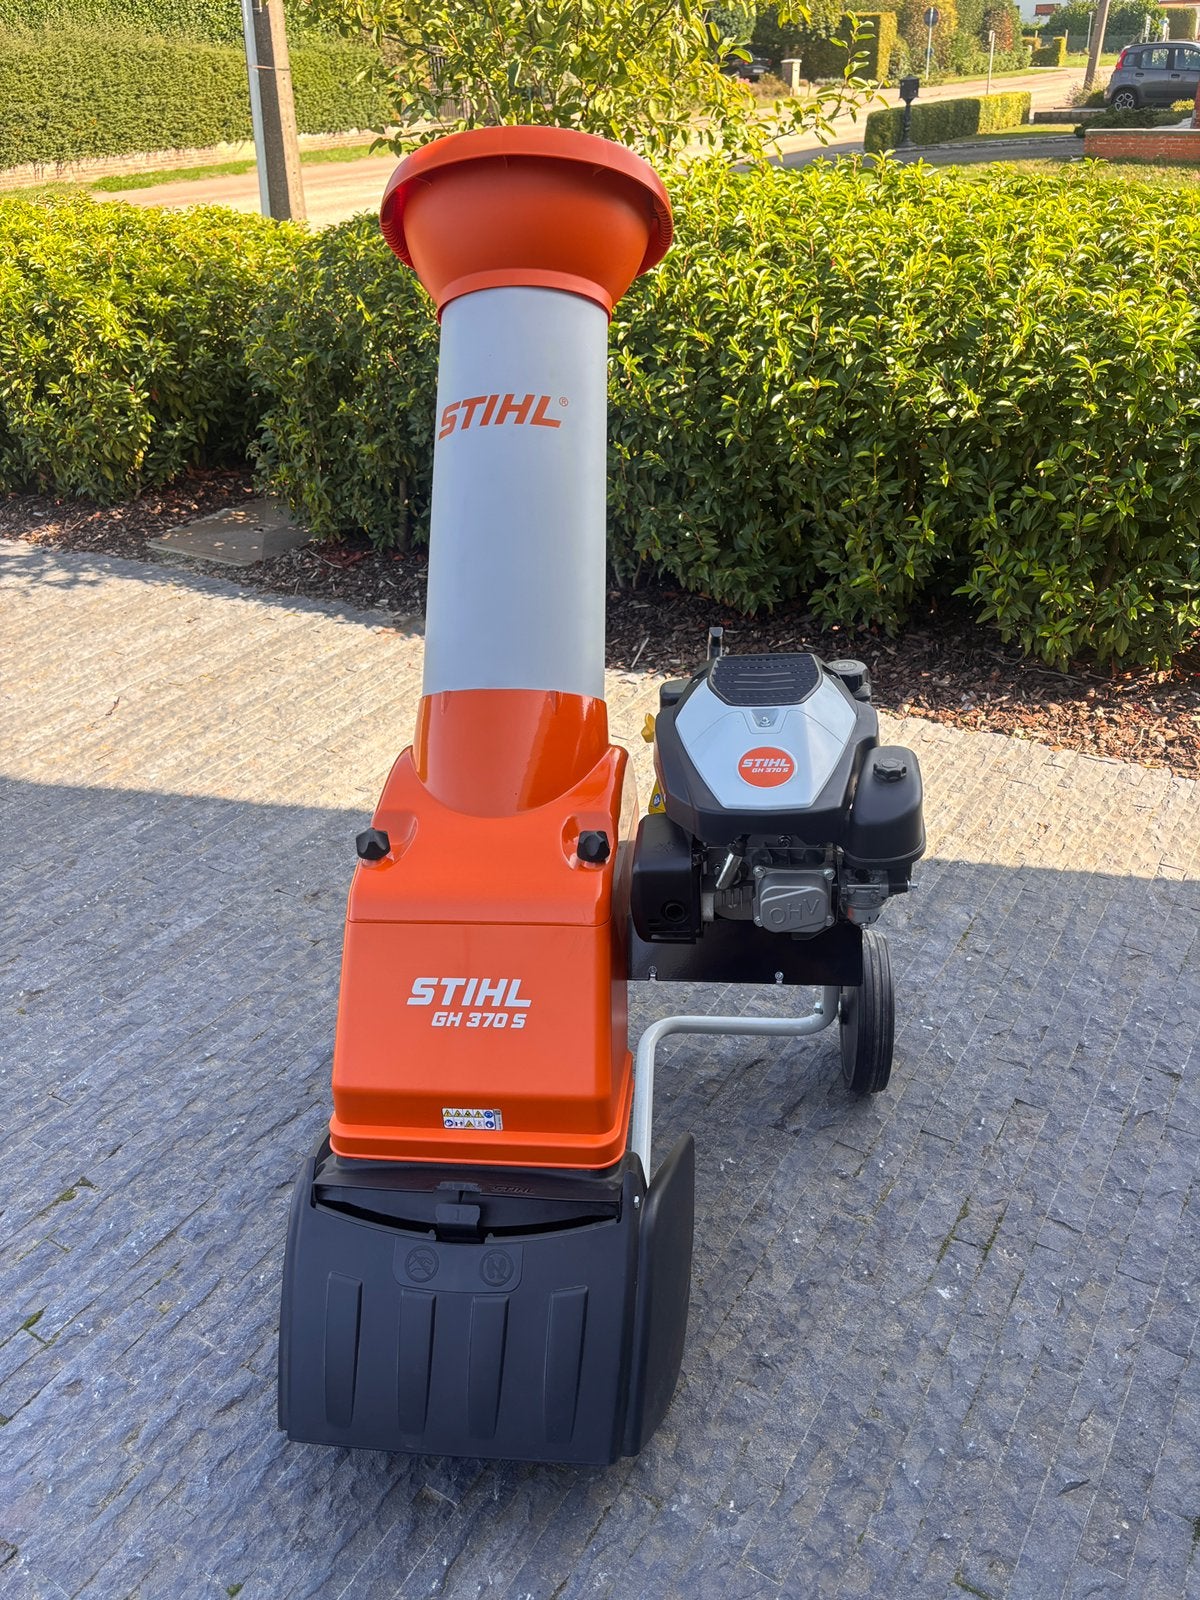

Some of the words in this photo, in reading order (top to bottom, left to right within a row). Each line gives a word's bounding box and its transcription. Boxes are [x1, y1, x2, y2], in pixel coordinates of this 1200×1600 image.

[741, 758, 791, 768] STIHL
[769, 898, 820, 925] OHV
[406, 977, 532, 1008] STIHL
[431, 1011, 463, 1027] GH
[466, 1012, 509, 1028] 370
[510, 1013, 527, 1029] S
